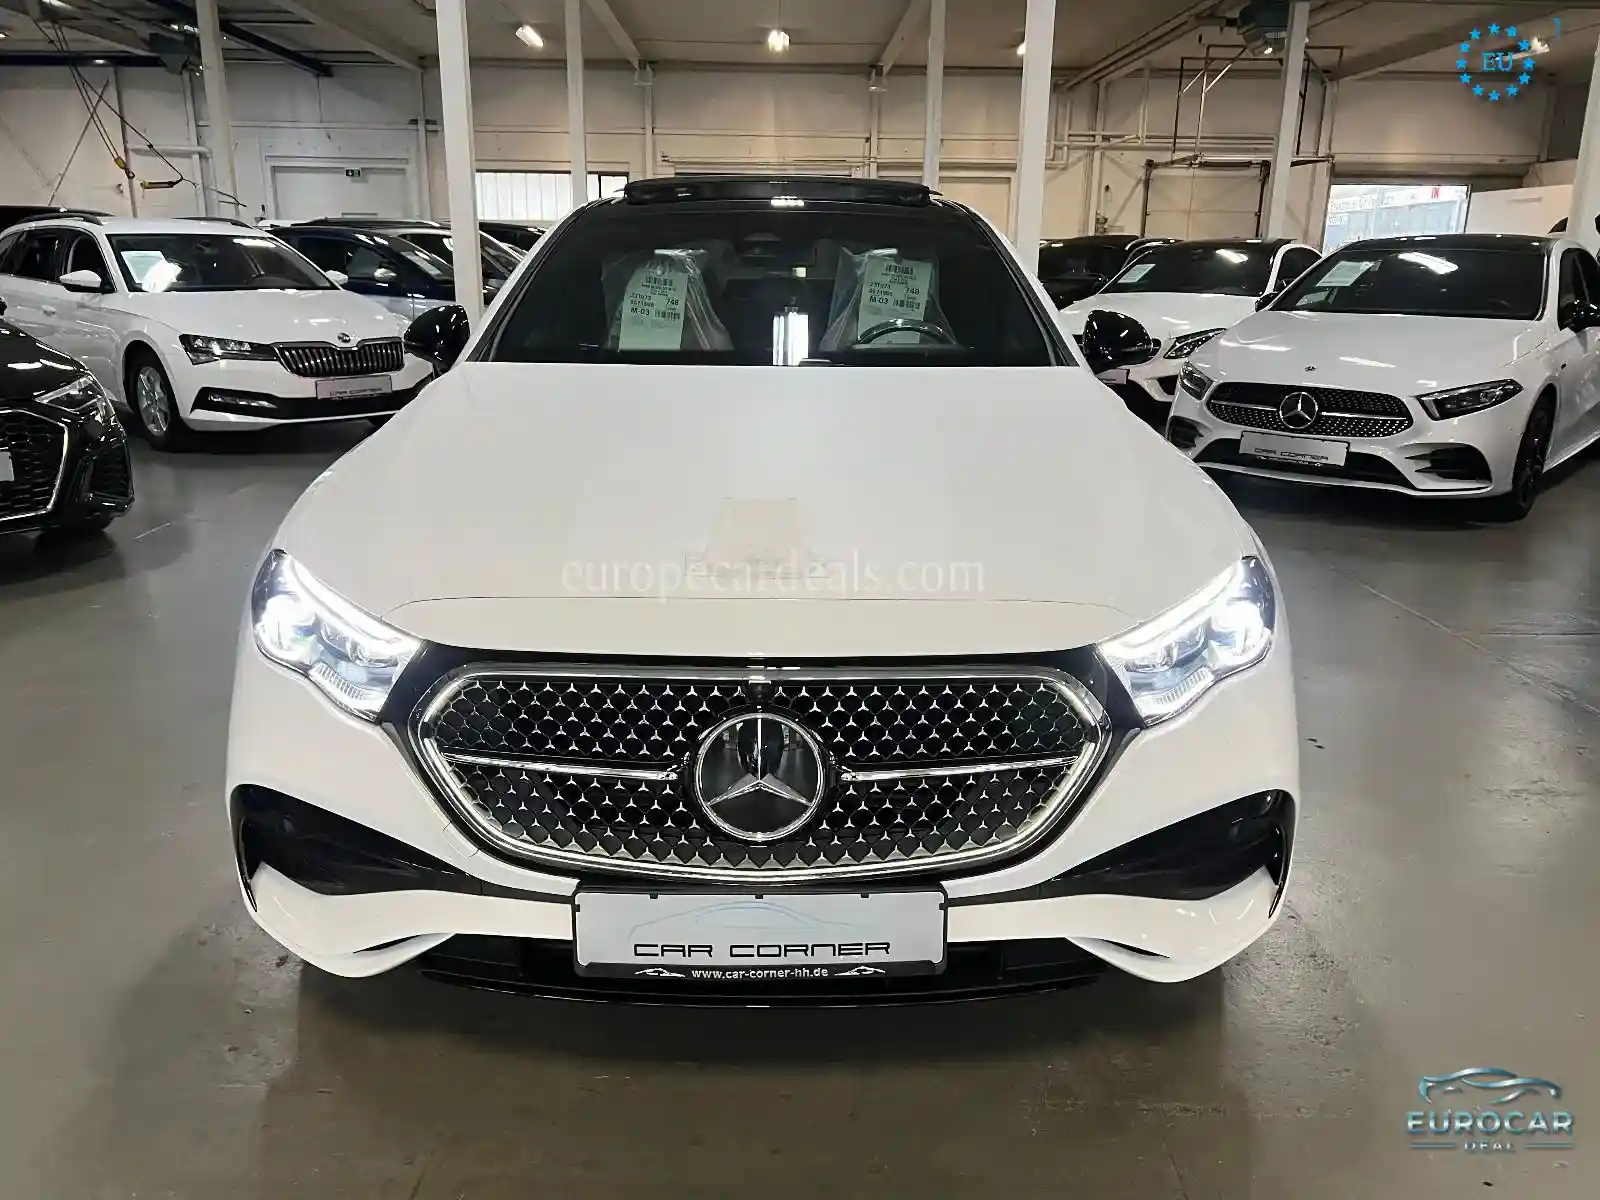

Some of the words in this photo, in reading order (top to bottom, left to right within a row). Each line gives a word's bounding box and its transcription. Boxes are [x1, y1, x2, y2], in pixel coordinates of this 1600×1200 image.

[905, 287, 920, 296] 748
[666, 298, 679, 307] 748
[869, 296, 889, 305] M-03
[630, 307, 650, 316] M-03
[634, 943, 713, 958] CAR
[729, 941, 891, 958] CORNER
[691, 967, 829, 980] www.car-corner-hh.de
